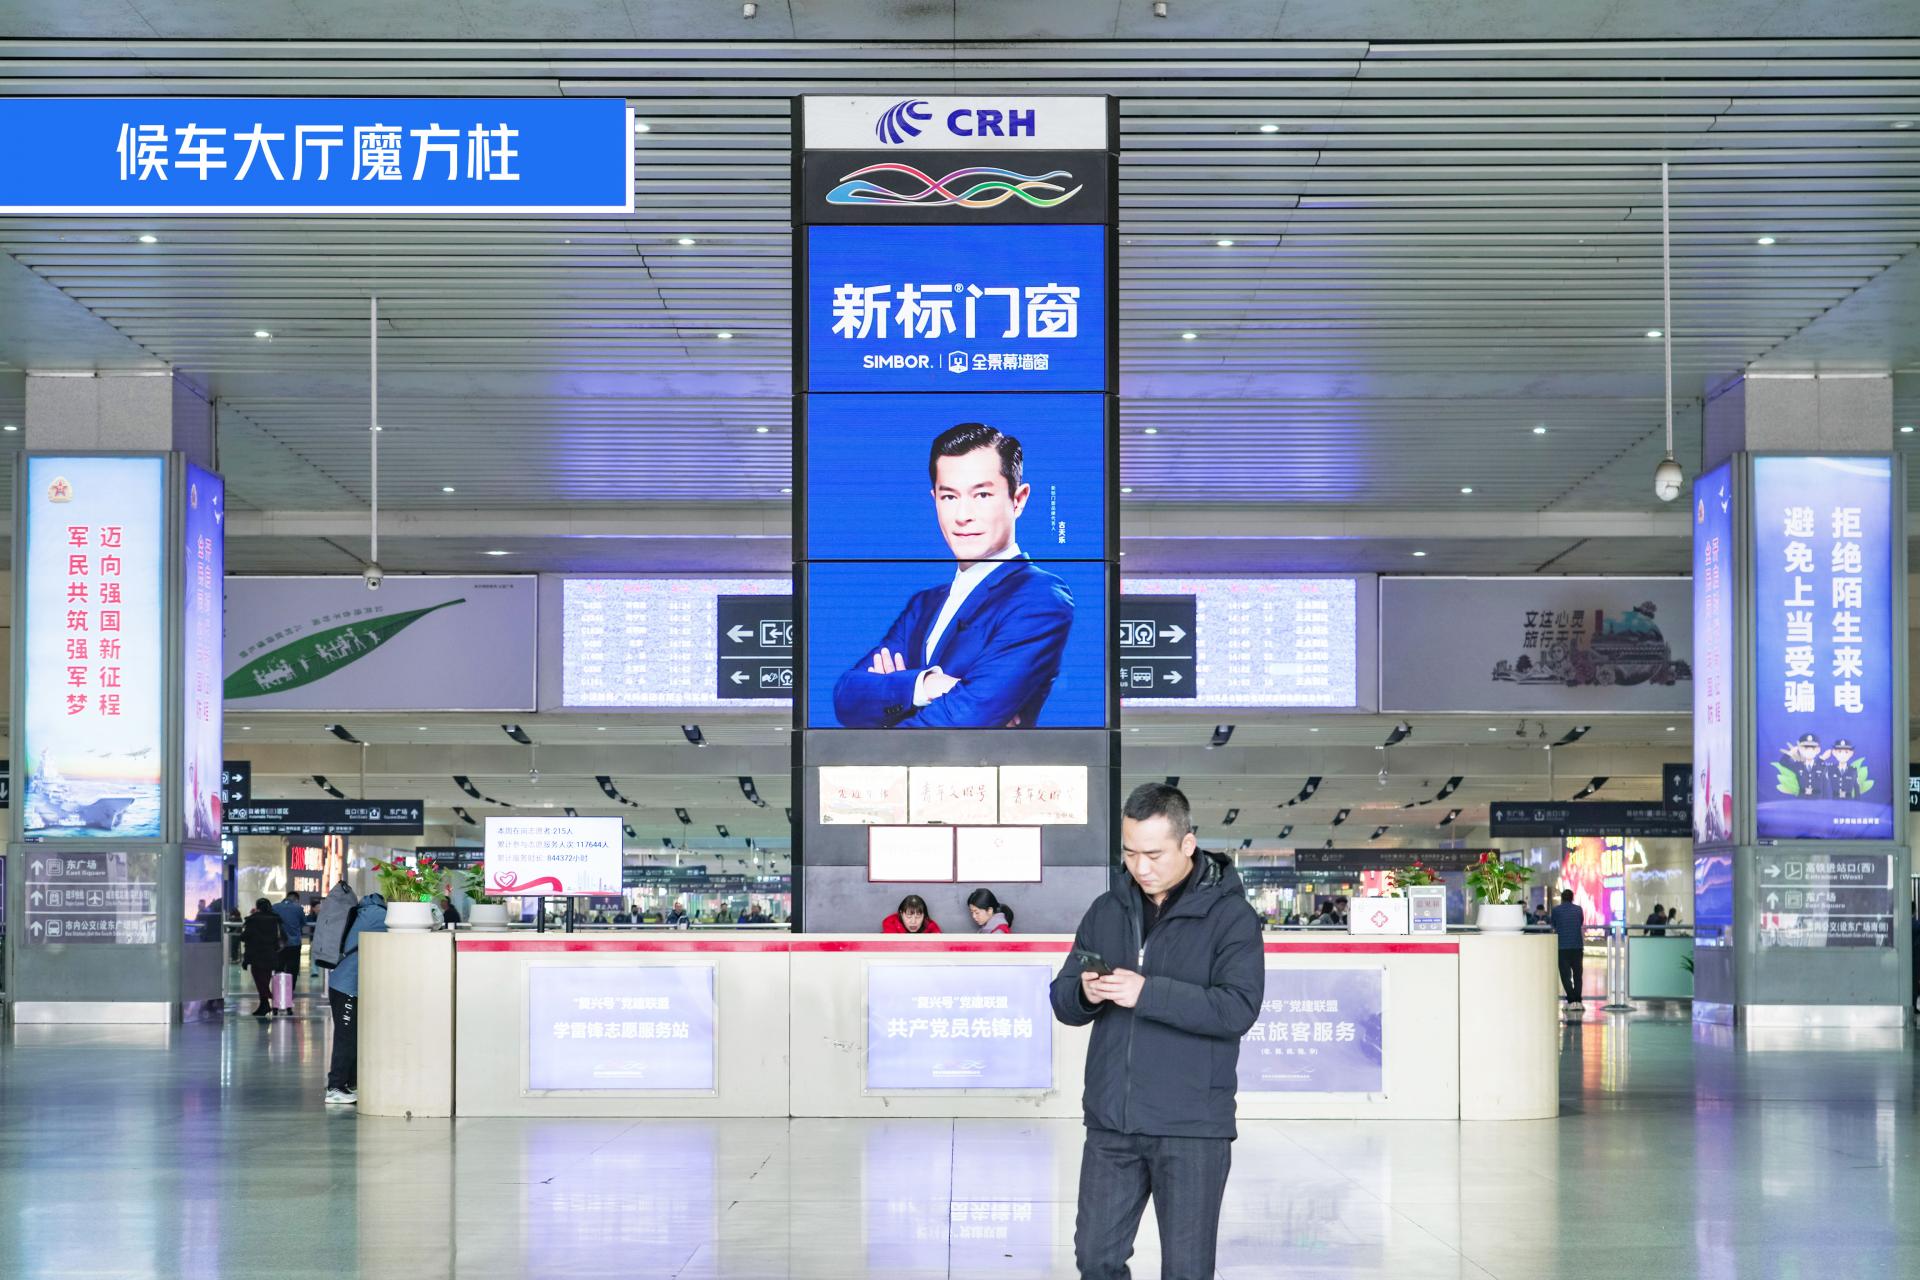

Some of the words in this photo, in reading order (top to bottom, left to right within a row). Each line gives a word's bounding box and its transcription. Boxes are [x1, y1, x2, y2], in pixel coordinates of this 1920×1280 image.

[946, 109, 1036, 137] CRH
[971, 353, 1049, 371] 全景幕墙窗
[66, 526, 89, 715] 军民共筑强军梦
[98, 526, 122, 716] 迈向强国新征程
[1783, 507, 1815, 714] 避免上当受骗
[1831, 507, 1864, 714] 拒绝陌生来电
[1523, 631, 1585, 649] 旅行天下
[66, 860, 97, 870] 东广场
[553, 1022, 690, 1039] 学雷锋志愿服务站
[887, 1018, 1033, 1039] 共产党员先锋岗
[1241, 1021, 1356, 1042] 点旅客服务
